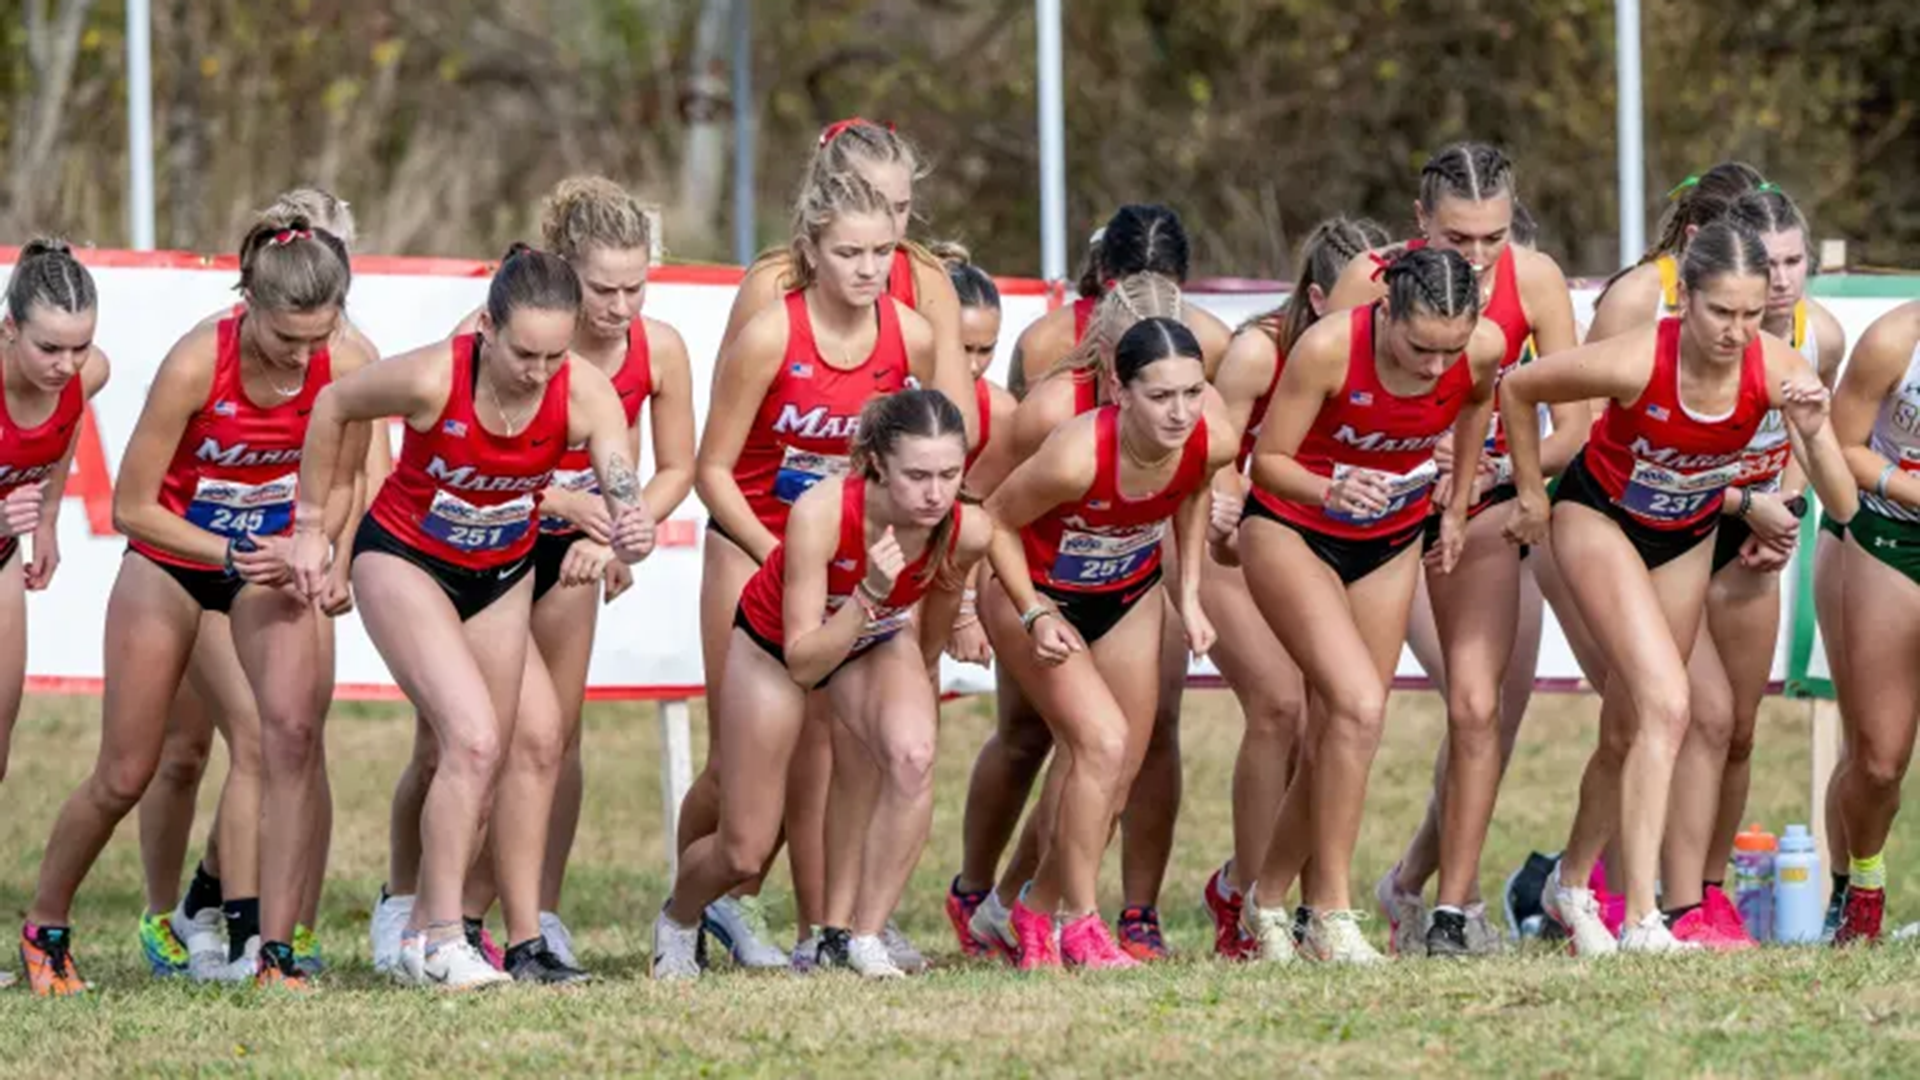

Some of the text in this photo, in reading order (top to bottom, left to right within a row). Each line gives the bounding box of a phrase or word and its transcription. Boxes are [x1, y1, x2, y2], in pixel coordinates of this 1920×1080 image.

[1648, 492, 1708, 513] 237
[208, 508, 266, 532] 245
[446, 526, 503, 547] 251
[1079, 554, 1136, 578] 257
